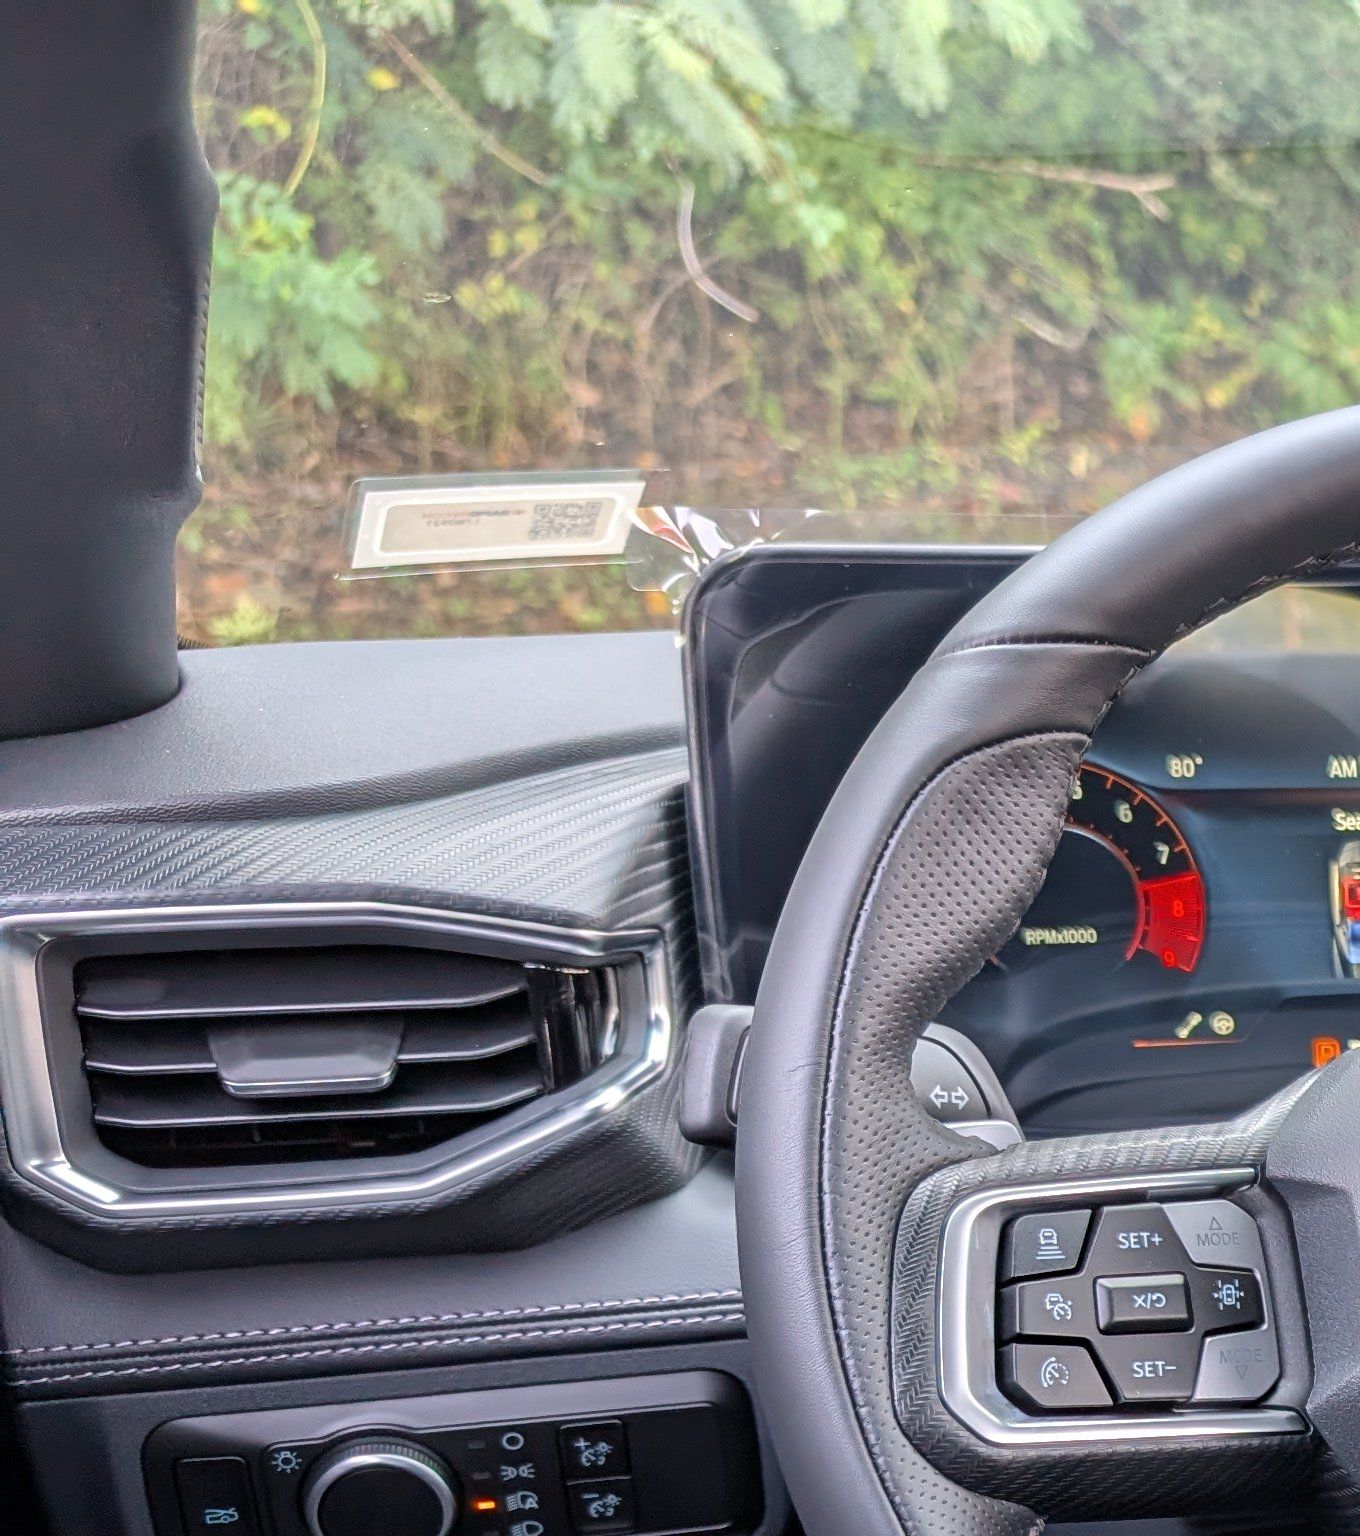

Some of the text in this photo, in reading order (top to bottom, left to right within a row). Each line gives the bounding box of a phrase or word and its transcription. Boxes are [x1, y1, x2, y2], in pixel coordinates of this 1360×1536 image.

[1328, 757, 1357, 778] AM
[1117, 802, 1133, 823] 6
[1154, 842, 1169, 865] 7
[1172, 900, 1184, 917] 8
[1118, 1231, 1163, 1249] SET+
[1197, 1232, 1241, 1247] MODE
[1219, 1349, 1263, 1364] MODE
